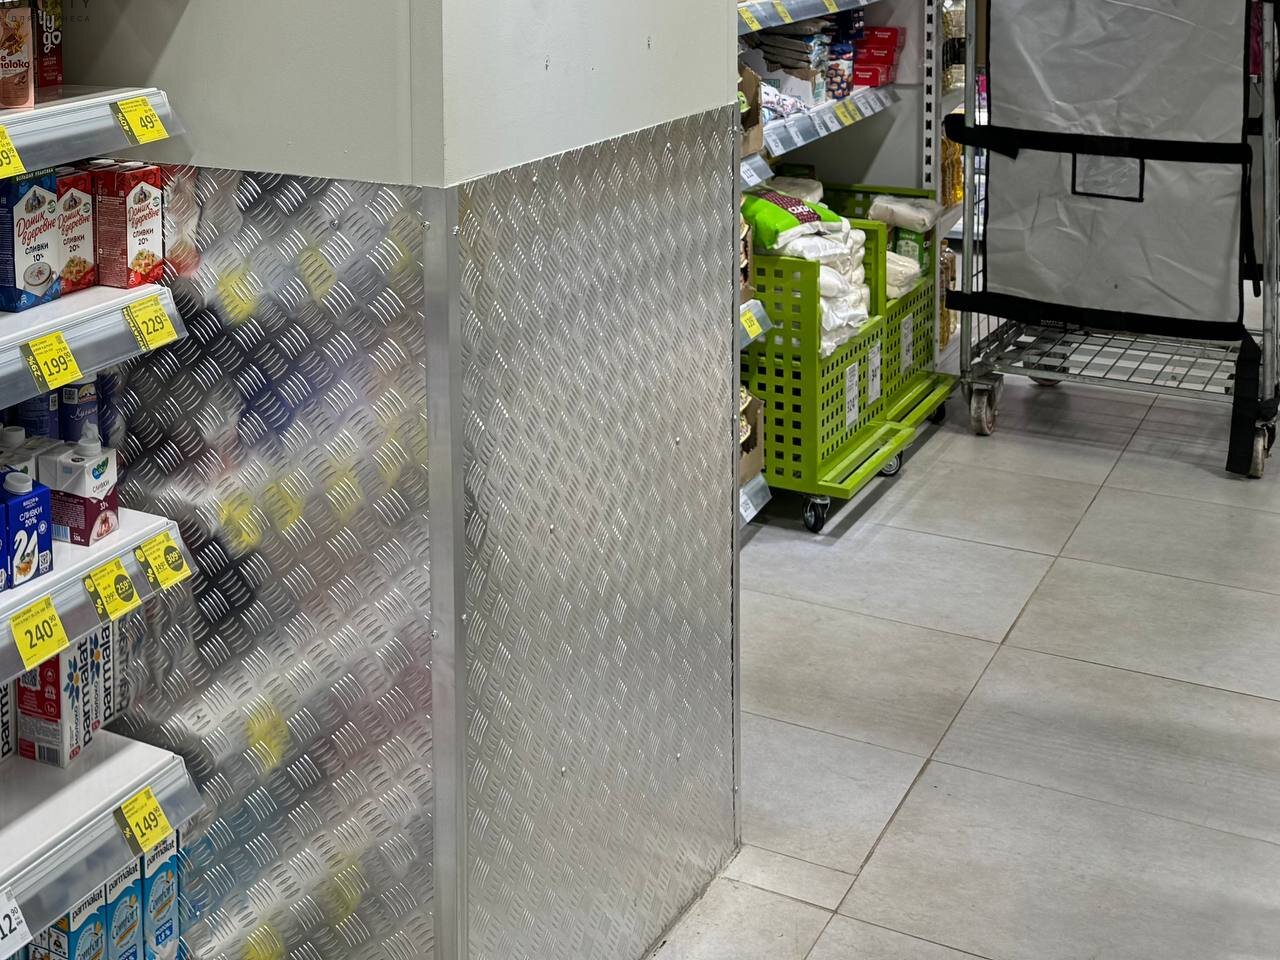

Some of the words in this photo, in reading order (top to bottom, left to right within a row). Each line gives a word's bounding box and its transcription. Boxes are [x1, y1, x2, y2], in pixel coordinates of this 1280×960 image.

[138, 114, 156, 131] 49
[141, 314, 165, 336] 229
[42, 354, 68, 377] 199
[24, 623, 54, 650] 240
[134, 811, 160, 838] 149
[146, 840, 175, 867] parmalat
[108, 862, 139, 894] parmalat
[71, 888, 104, 922] parmalat
